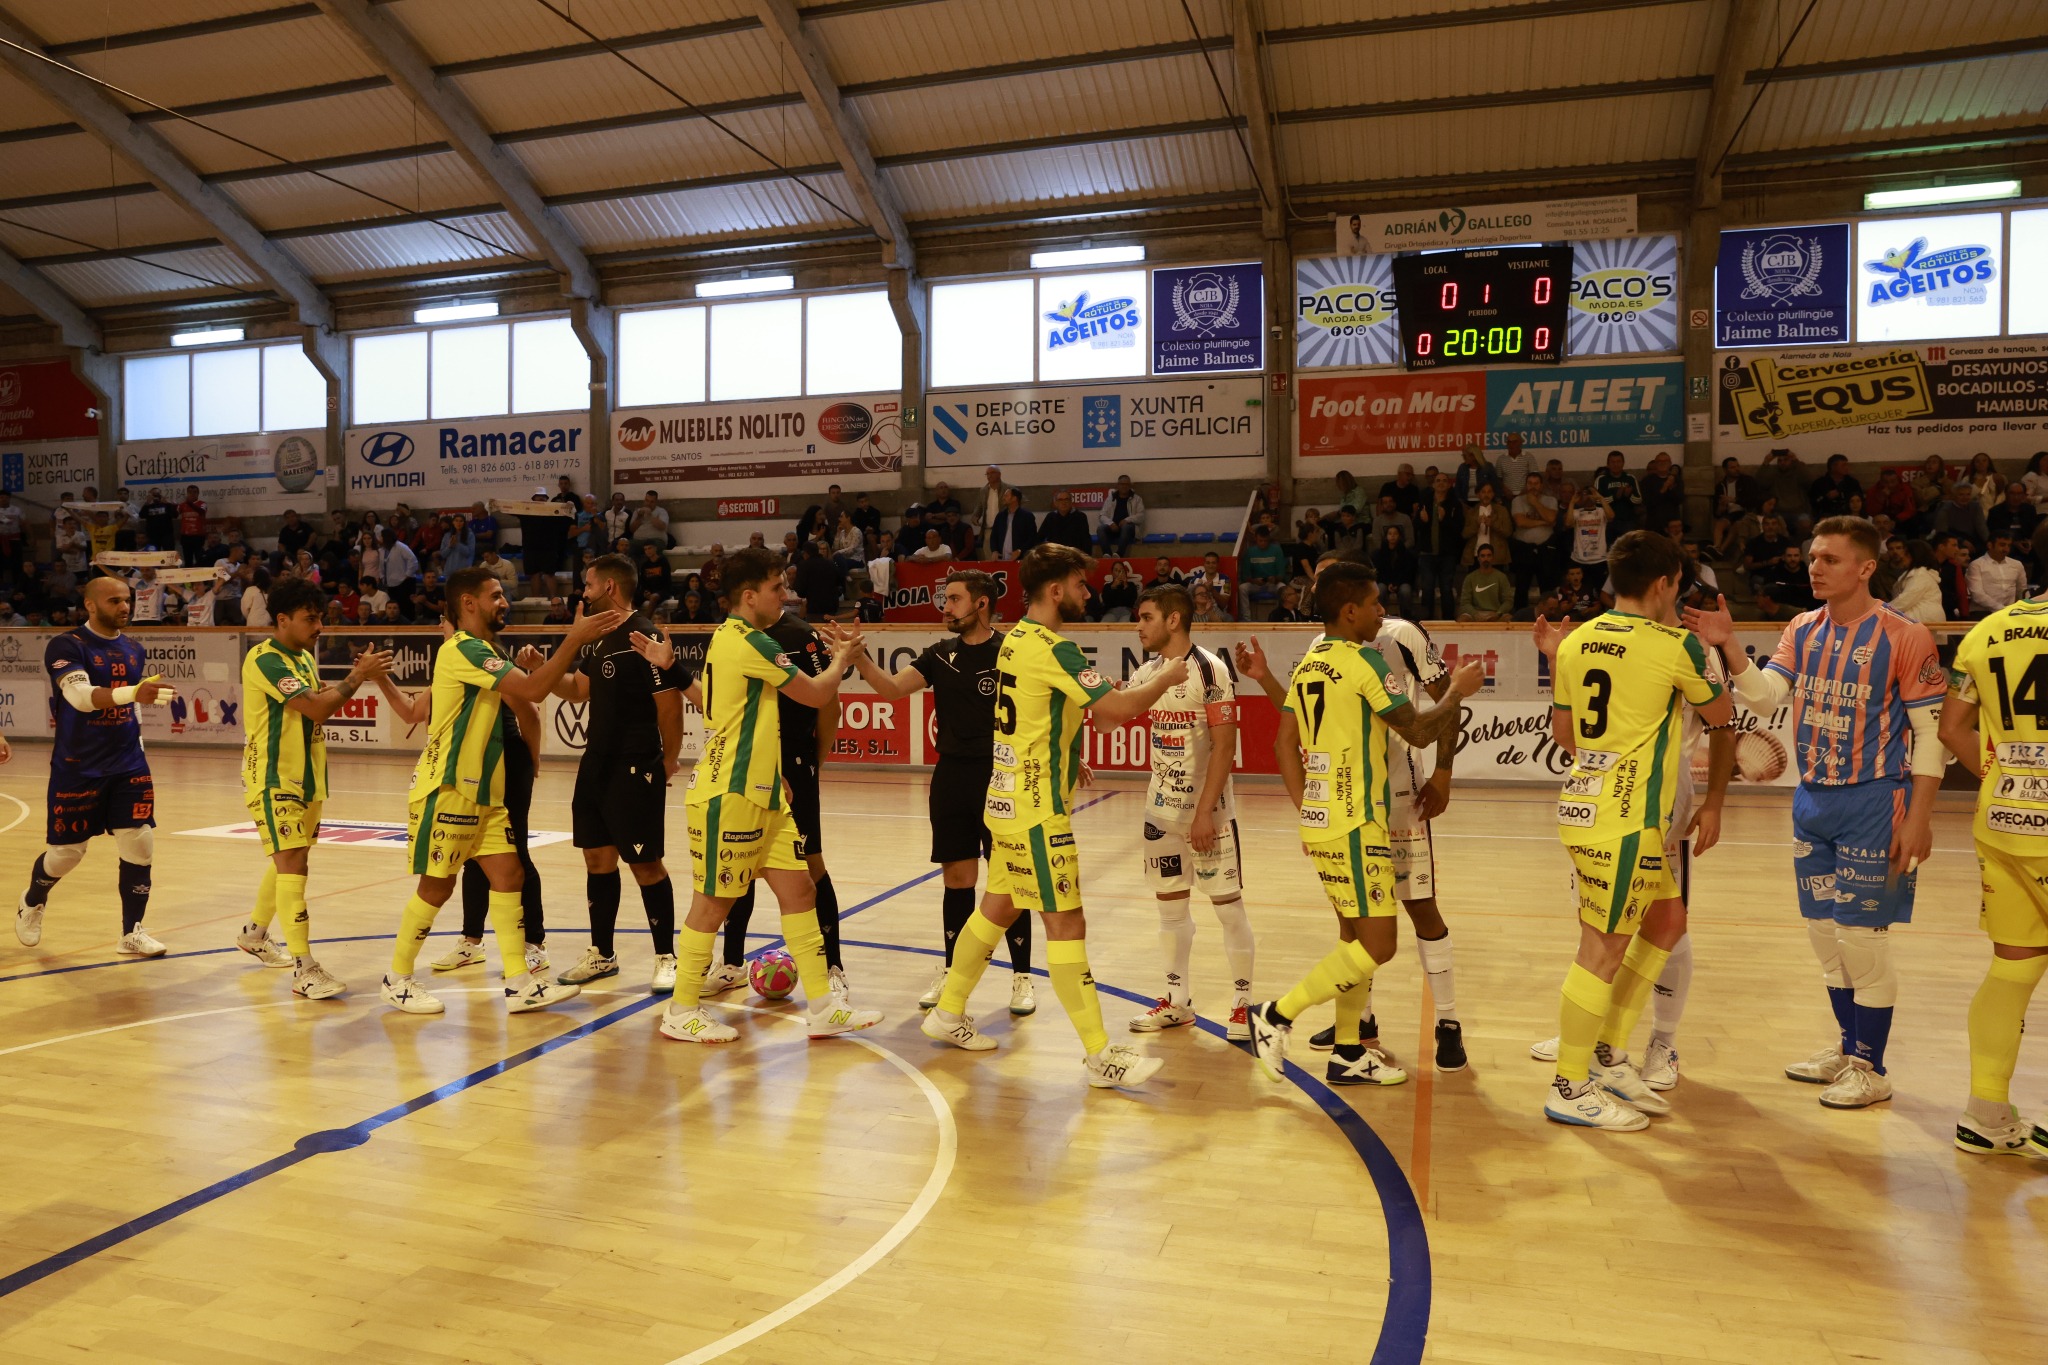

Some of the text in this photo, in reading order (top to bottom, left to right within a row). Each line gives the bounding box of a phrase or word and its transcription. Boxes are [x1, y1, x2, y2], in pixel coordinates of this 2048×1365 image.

[1384, 213, 1532, 236] ADRIÁN GALLEGO
[1499, 233, 1532, 242] Deportiva
[1464, 250, 1499, 259] MONDO
[1767, 254, 1796, 267] CJB
[1919, 250, 1978, 269] RÓTULOS
[1423, 265, 1448, 275] LOCAL
[1507, 260, 1550, 270] VISITANTE
[1870, 260, 1992, 303] AGEITOS
[1193, 290, 1218, 302] CJB
[1441, 282, 1458, 309] 0
[1484, 283, 1490, 304] 1
[1534, 277, 1551, 304] 0
[1084, 301, 1128, 318] RÓTULOS
[1299, 291, 1397, 315] PACO'S
[1588, 299, 1643, 309] MODA.ES
[1322, 313, 1373, 323] MODA.ES
[1468, 308, 1497, 317] PERIODO
[1726, 309, 1834, 322] Colexio plurilingüe
[1049, 309, 1139, 348] AGEITOS
[1721, 322, 1839, 342] Jaime Balmes
[1161, 339, 1251, 351] Colexio plurilingüe
[1417, 333, 1432, 355] 0
[1444, 326, 1522, 357] 20:00
[1535, 327, 1549, 350] 0
[1531, 353, 1555, 361] FALTAS
[1779, 352, 1818, 360] Alameda
[1819, 352, 1831, 360] de
[1949, 348, 1985, 356] Cerveza
[2003, 345, 2038, 354] tanque,
[1157, 351, 1255, 369] Jaime Balmes
[1412, 358, 1436, 367] FALTAS
[1777, 349, 1916, 382] Cervecería
[1951, 360, 2048, 377] DESAYUNOS
[1501, 376, 1666, 416] ATLEET
[1787, 375, 1916, 416] EQUS
[975, 398, 1065, 418] DEPORTE
[1130, 394, 1204, 416] XUNTA
[1309, 391, 1476, 418] Foot on Mars
[659, 411, 806, 444] MUEBLES NOLITO
[821, 422, 868, 431] DESCANSO
[822, 414, 856, 424] RINCÓN
[1130, 415, 1251, 438] DE GALICIA
[1785, 408, 1903, 433] TAPERÍA-BURGUER
[975, 419, 1056, 437] GALEGO
[1867, 421, 2037, 435] Haz tus pedidos para llevar
[439, 428, 583, 460] Ramacar
[28, 453, 69, 469] XUNTA
[125, 449, 207, 480] Grafinoia
[670, 452, 703, 462] SANTOS
[282, 464, 316, 477] MARKETING
[440, 458, 581, 475] Telfs. 981 826 603 618 891 775
[28, 468, 95, 485] DE GALICIA
[351, 472, 426, 490] HYUNDAI
[202, 485, 267, 499] www.grafinoia.com
[728, 499, 775, 515] SECTOR 10
[883, 585, 932, 611] NOIA
[145, 645, 196, 660] utación
[1581, 642, 1626, 659] POWER
[14, 665, 40, 673] TAMBRE
[111, 662, 127, 677] 28
[1311, 661, 1343, 685] FERRAZ
[1795, 672, 1873, 700] TUBANOR
[1988, 653, 2048, 731] 14
[1579, 668, 1612, 740] 3
[1296, 681, 1325, 746] 17
[1804, 705, 1851, 729] BigMat
[349, 729, 379, 742] S.L.
[868, 738, 899, 756] S.L.
[1496, 745, 1528, 766] de
[1345, 766, 1354, 818] DIPUTACIÓN
[1619, 759, 1638, 818] DIPUTACIÓN
[1990, 811, 2048, 827] XPECAD
[723, 830, 762, 841] Rapimuebl
[1006, 861, 1033, 876] Blanca
[1150, 856, 1179, 869] USC
[1800, 875, 1836, 891] USC
[1854, 874, 1885, 882] GALLEGO
